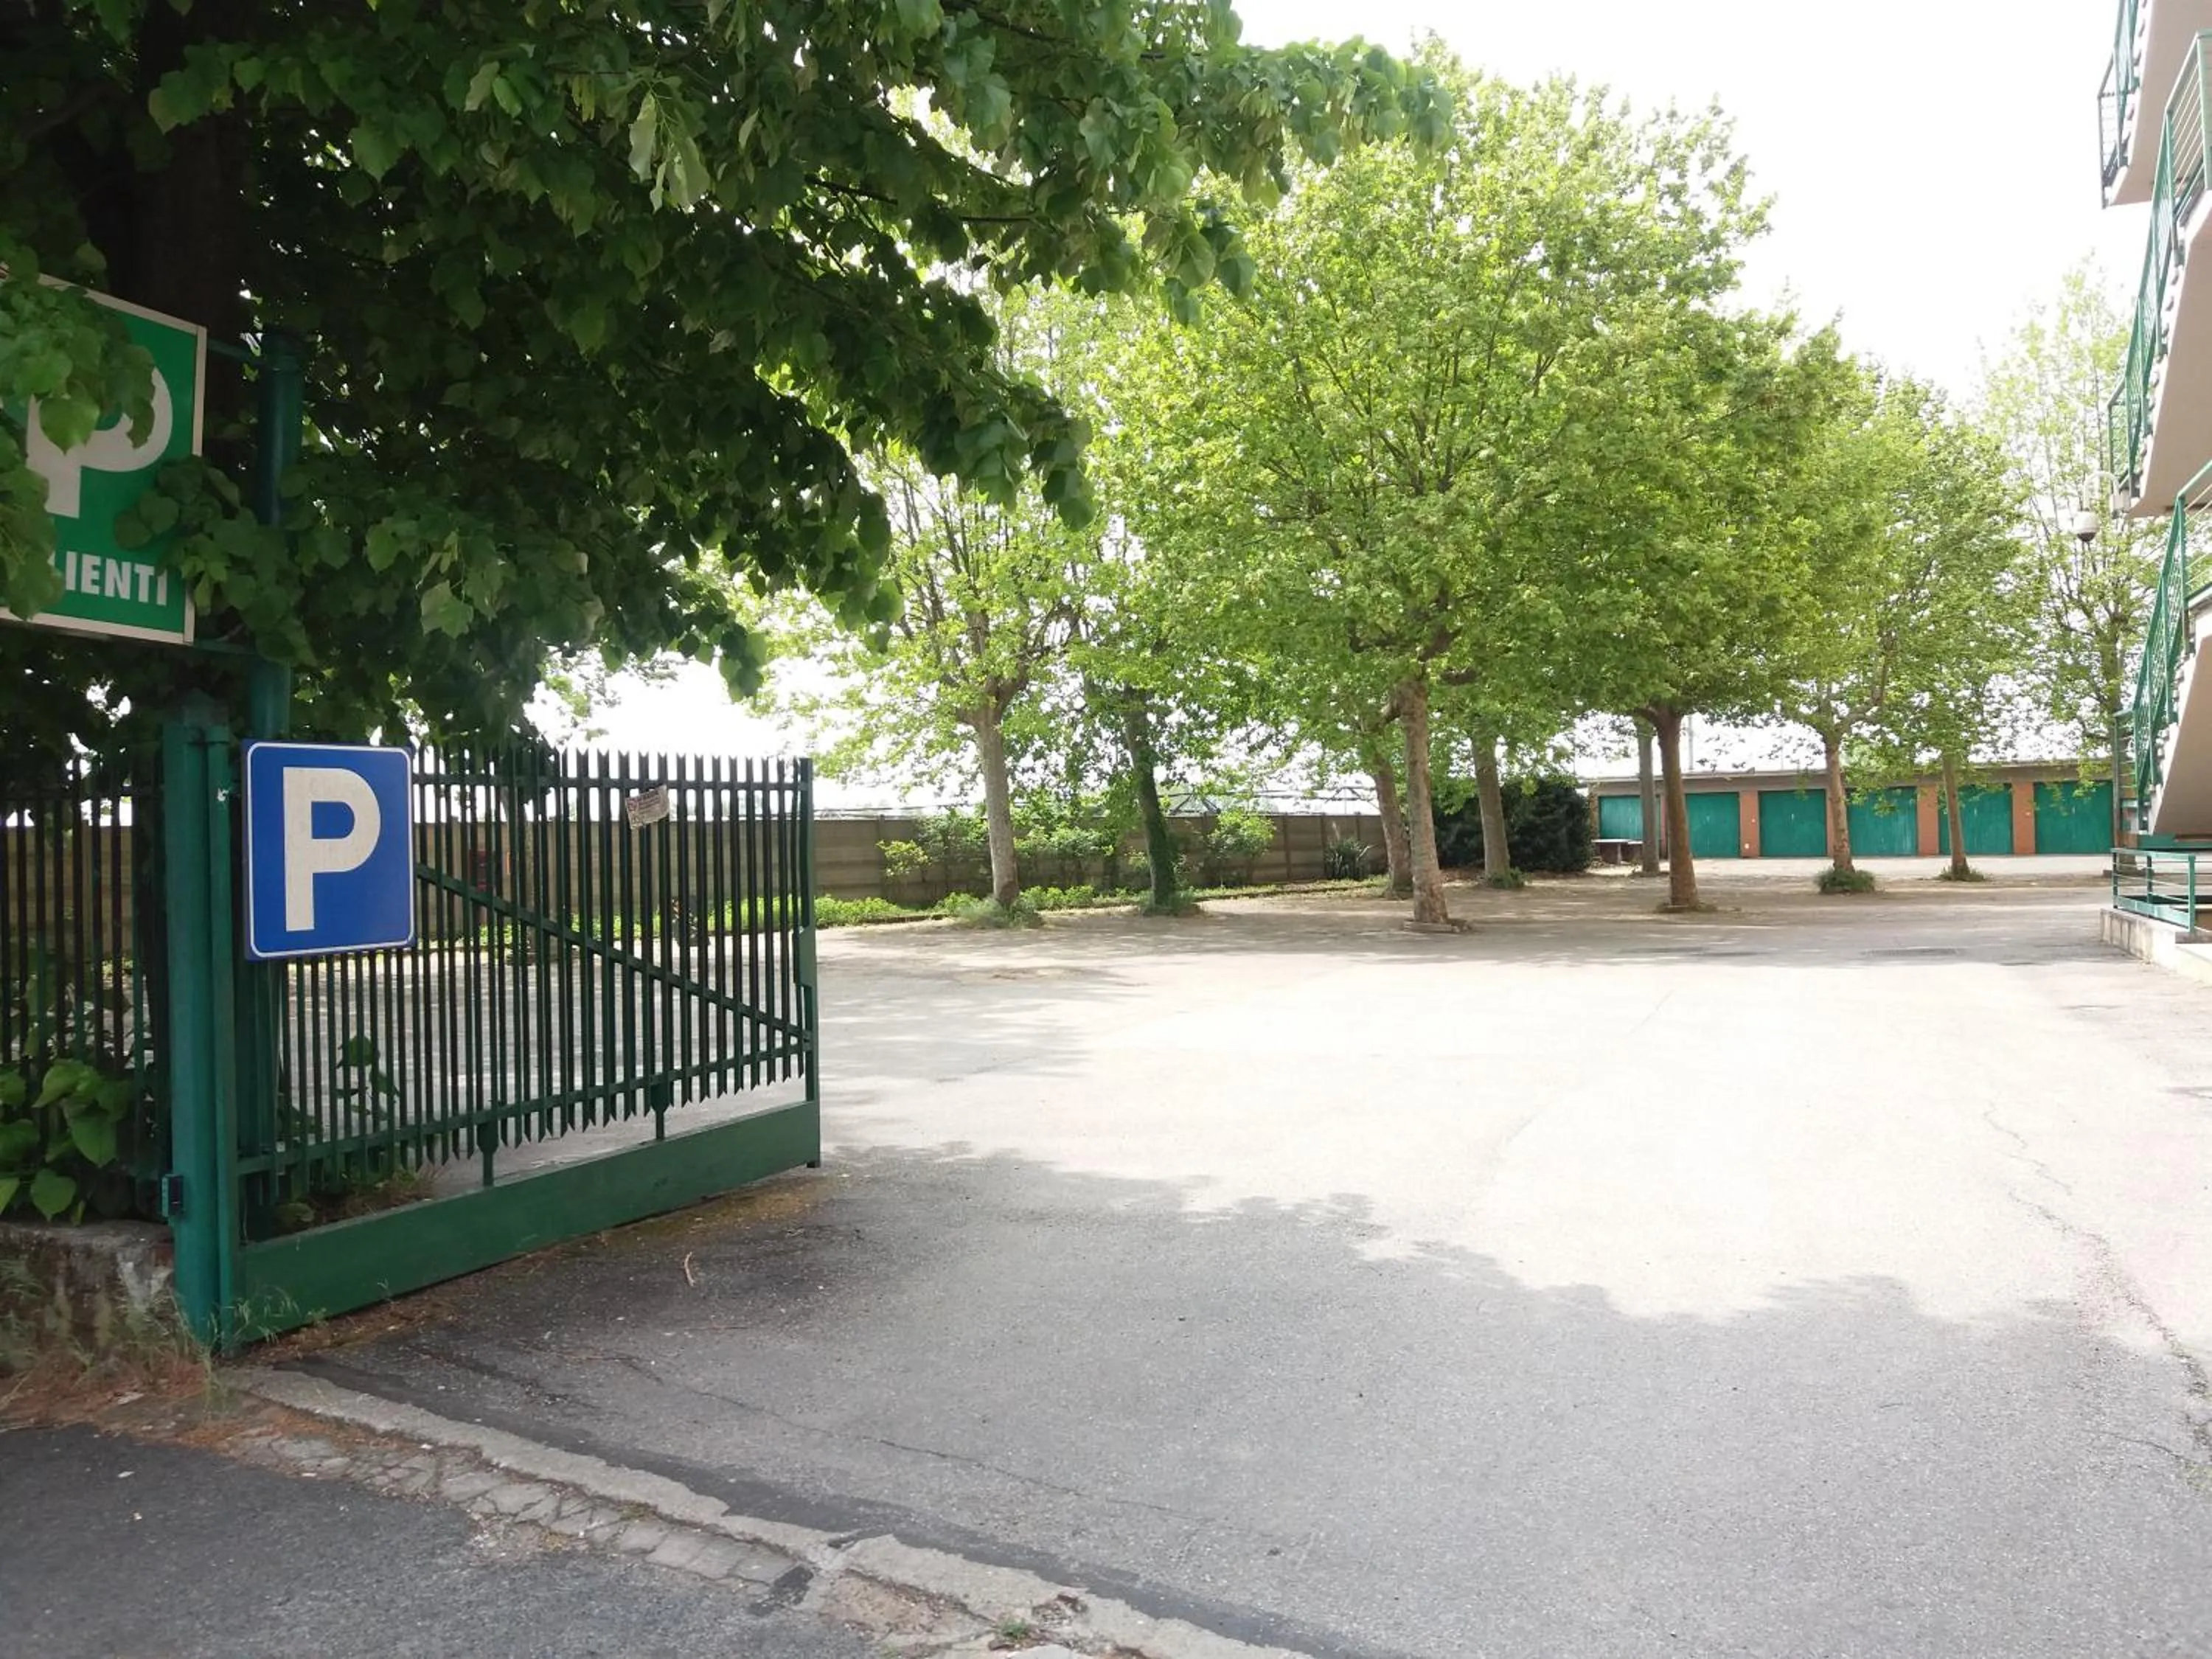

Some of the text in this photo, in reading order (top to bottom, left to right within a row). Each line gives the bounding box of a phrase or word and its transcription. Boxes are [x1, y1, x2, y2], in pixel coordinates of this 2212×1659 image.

[26, 361, 173, 518] P
[47, 550, 167, 606] IENTI
[282, 766, 381, 932] P
